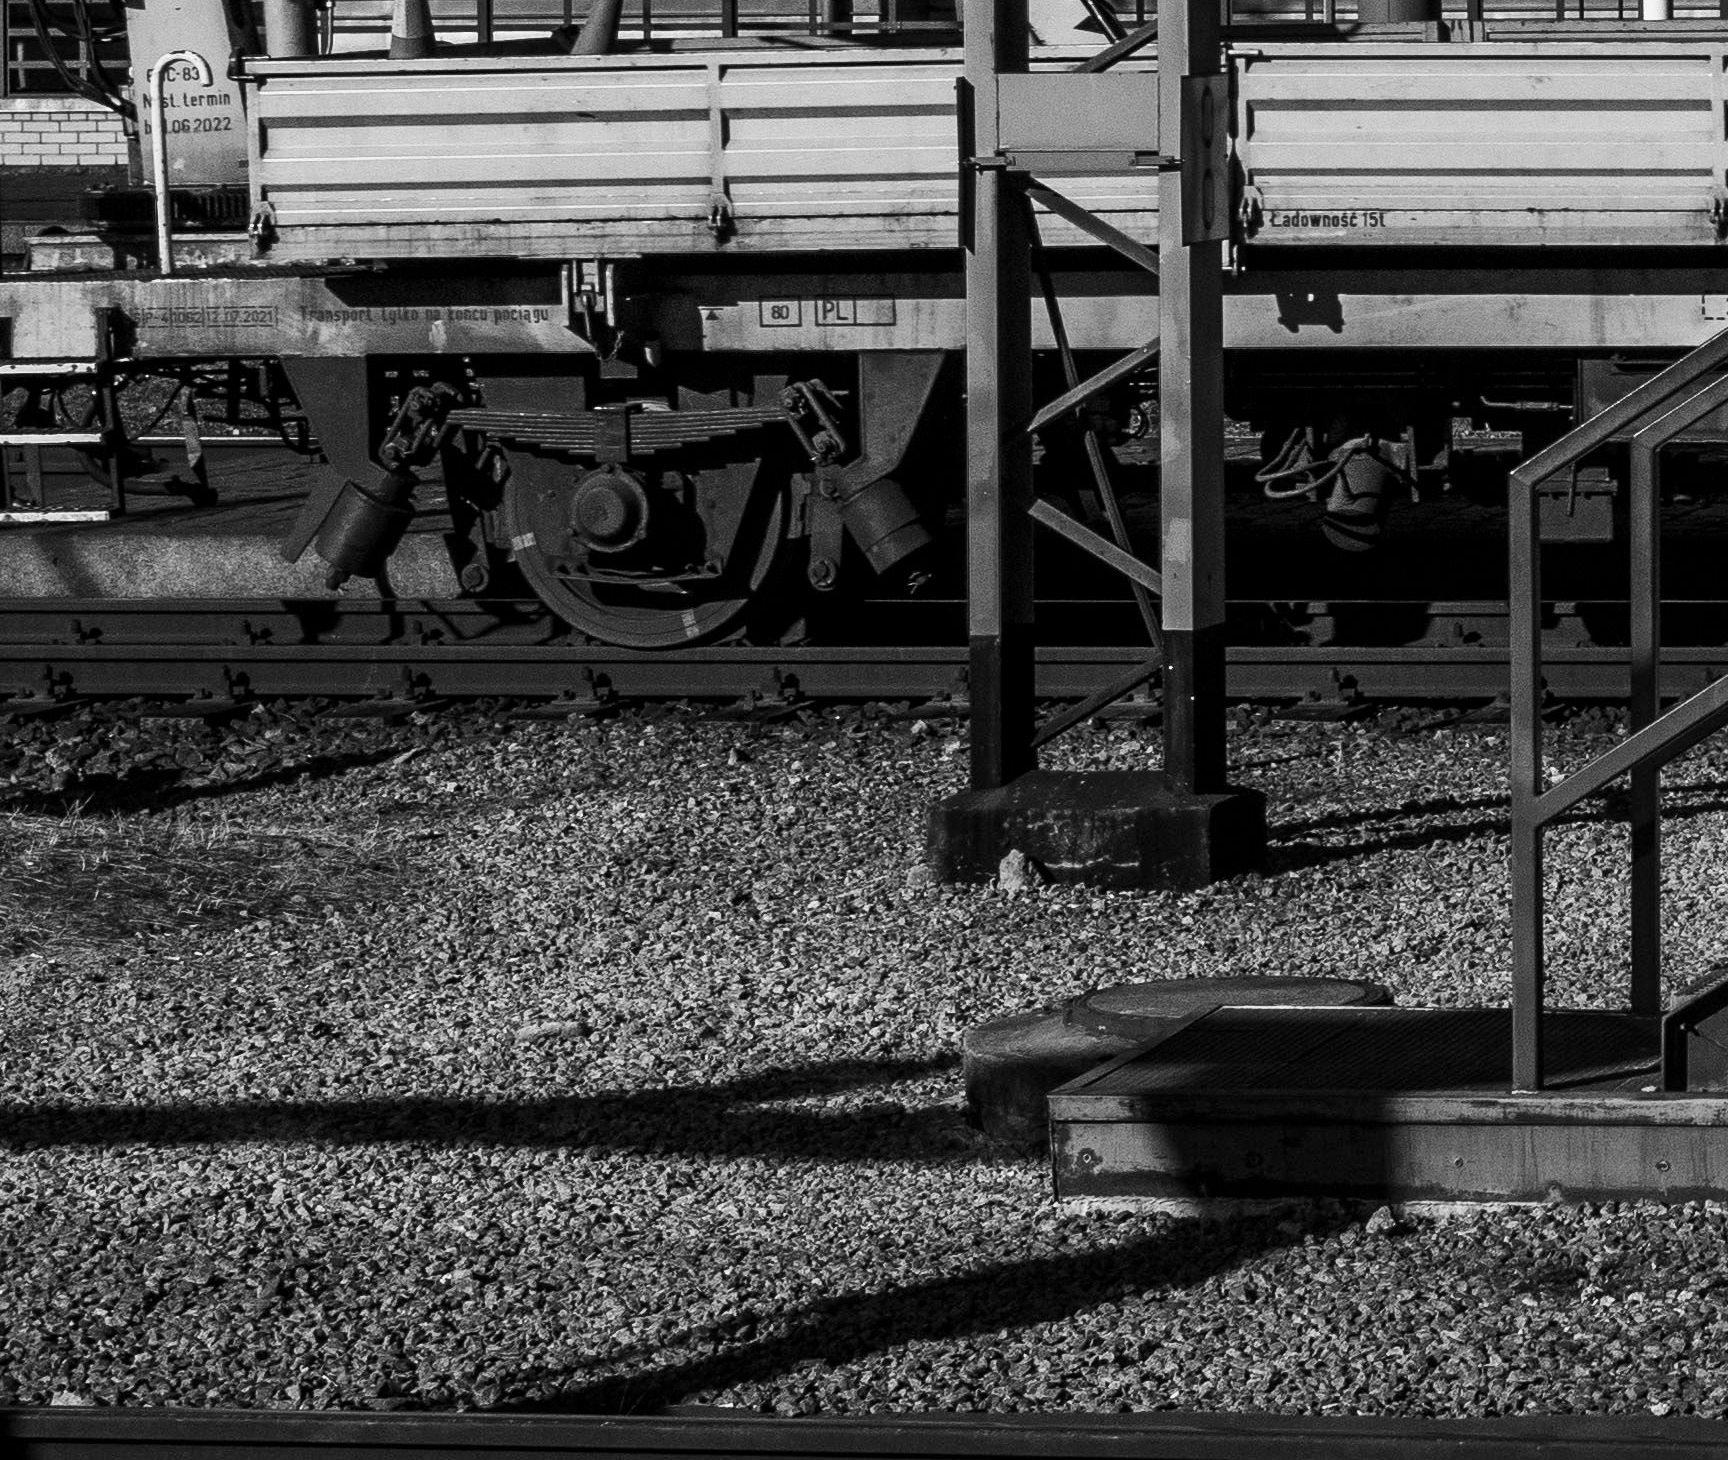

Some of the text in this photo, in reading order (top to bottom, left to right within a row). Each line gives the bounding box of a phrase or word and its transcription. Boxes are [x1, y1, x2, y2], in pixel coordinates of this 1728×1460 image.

[146, 67, 200, 83] EC-83
[142, 89, 231, 109] Nst. termin
[1269, 210, 1386, 228] Ładowność 15t
[300, 305, 373, 325] Transport
[382, 306, 419, 325] tylko
[426, 307, 442, 321] na
[494, 306, 549, 325] pociągu
[771, 305, 790, 320] 80
[822, 298, 849, 321] PL
